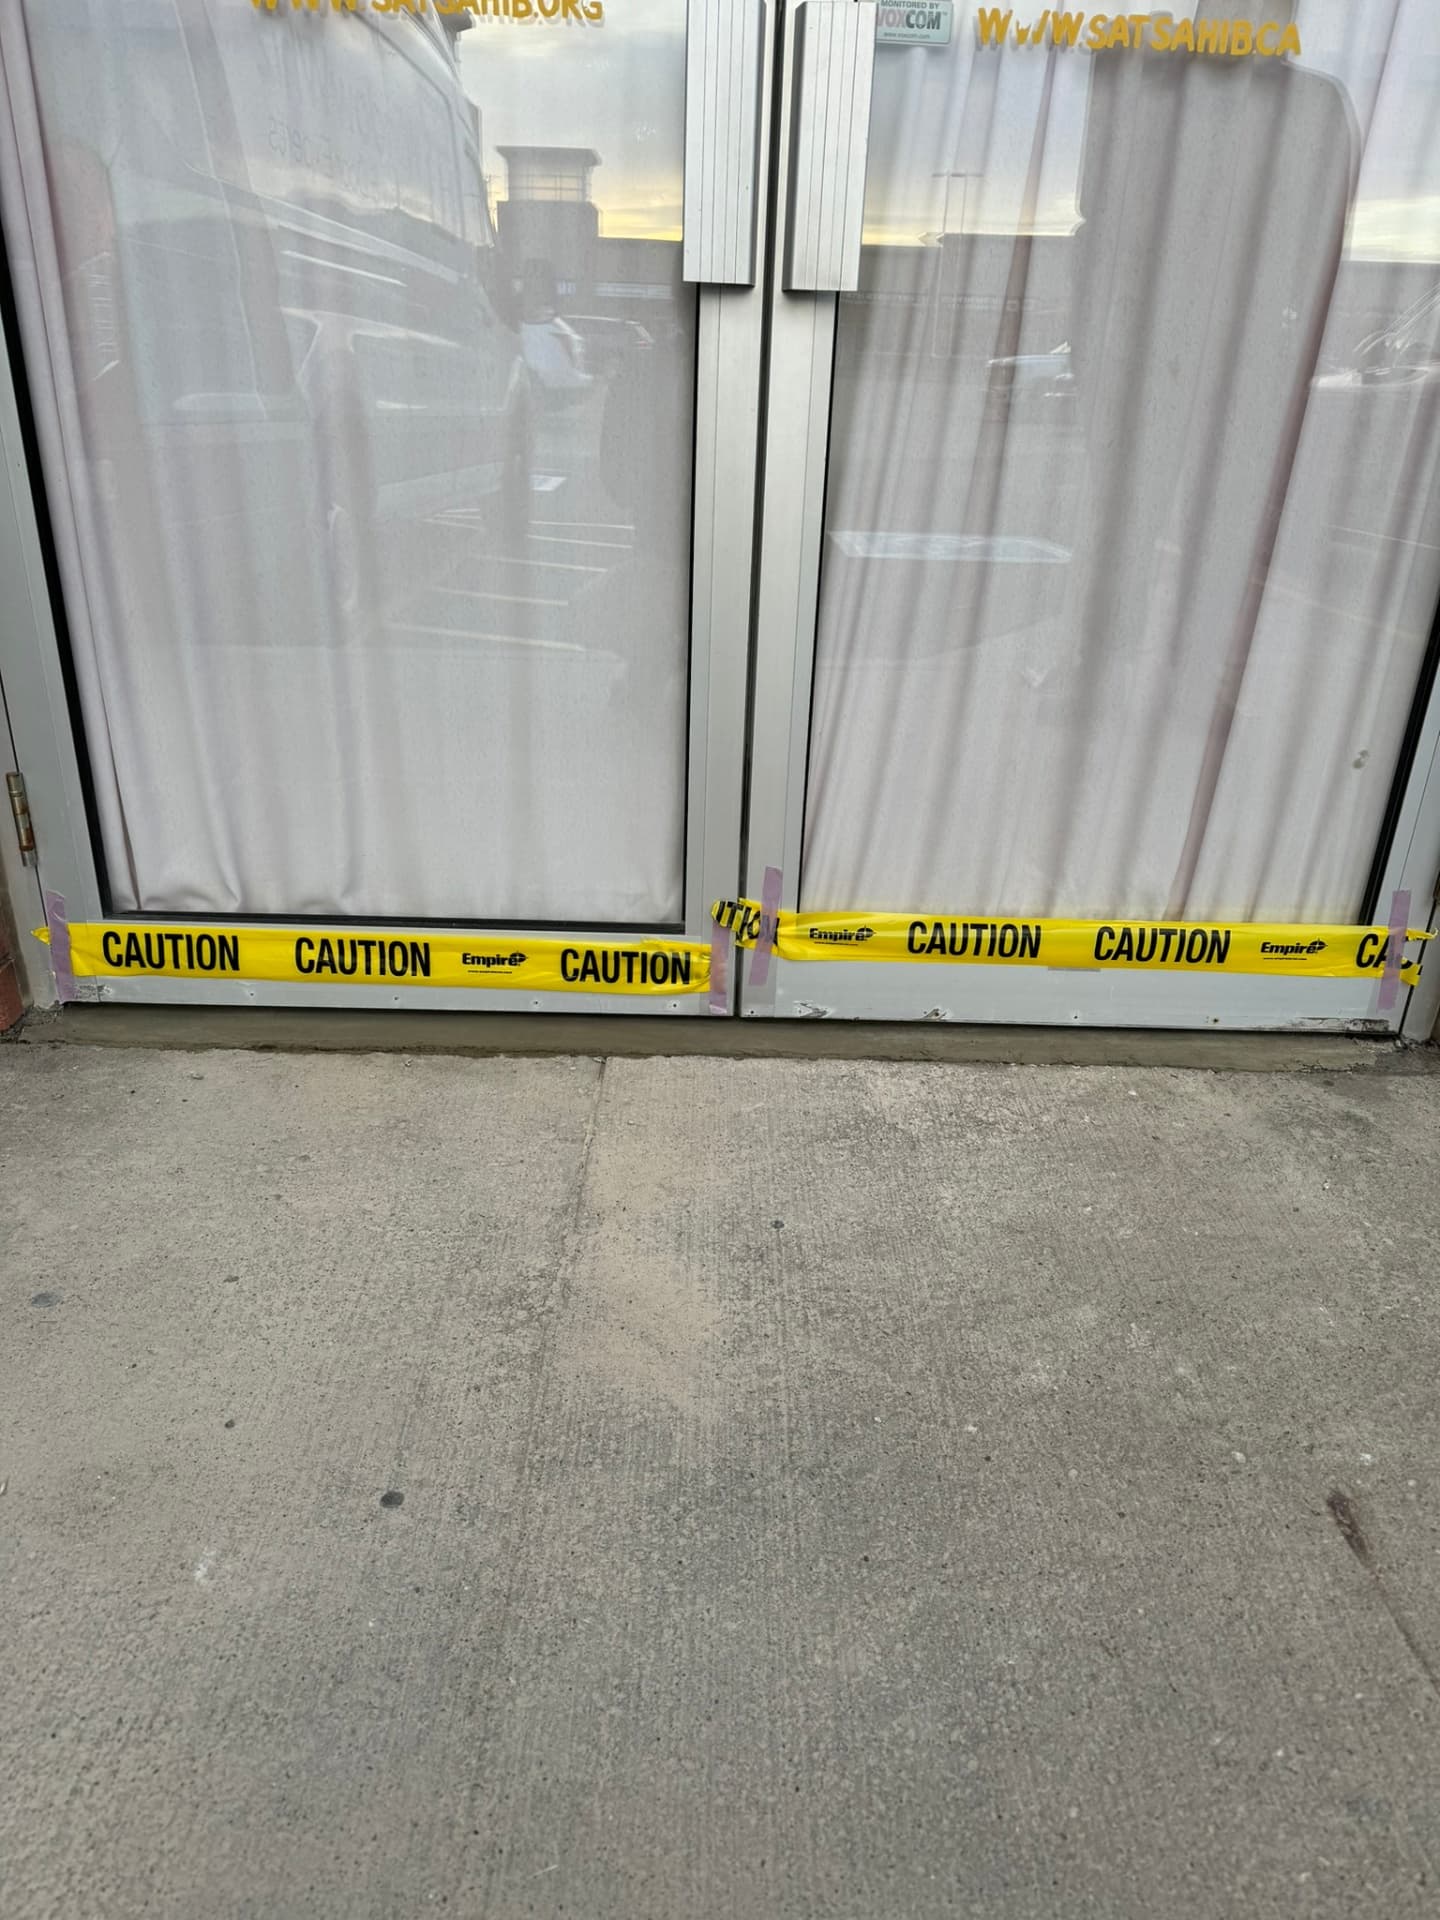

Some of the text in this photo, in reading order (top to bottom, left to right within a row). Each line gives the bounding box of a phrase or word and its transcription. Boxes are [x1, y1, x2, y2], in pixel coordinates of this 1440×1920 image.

[102, 931, 691, 985] CAUTION CAUTION Empire CAUTION
[809, 927, 867, 941] Empire
[907, 921, 1041, 959] CAUTION
[1094, 926, 1231, 964] CAUTION
[1260, 940, 1318, 956] Empire
